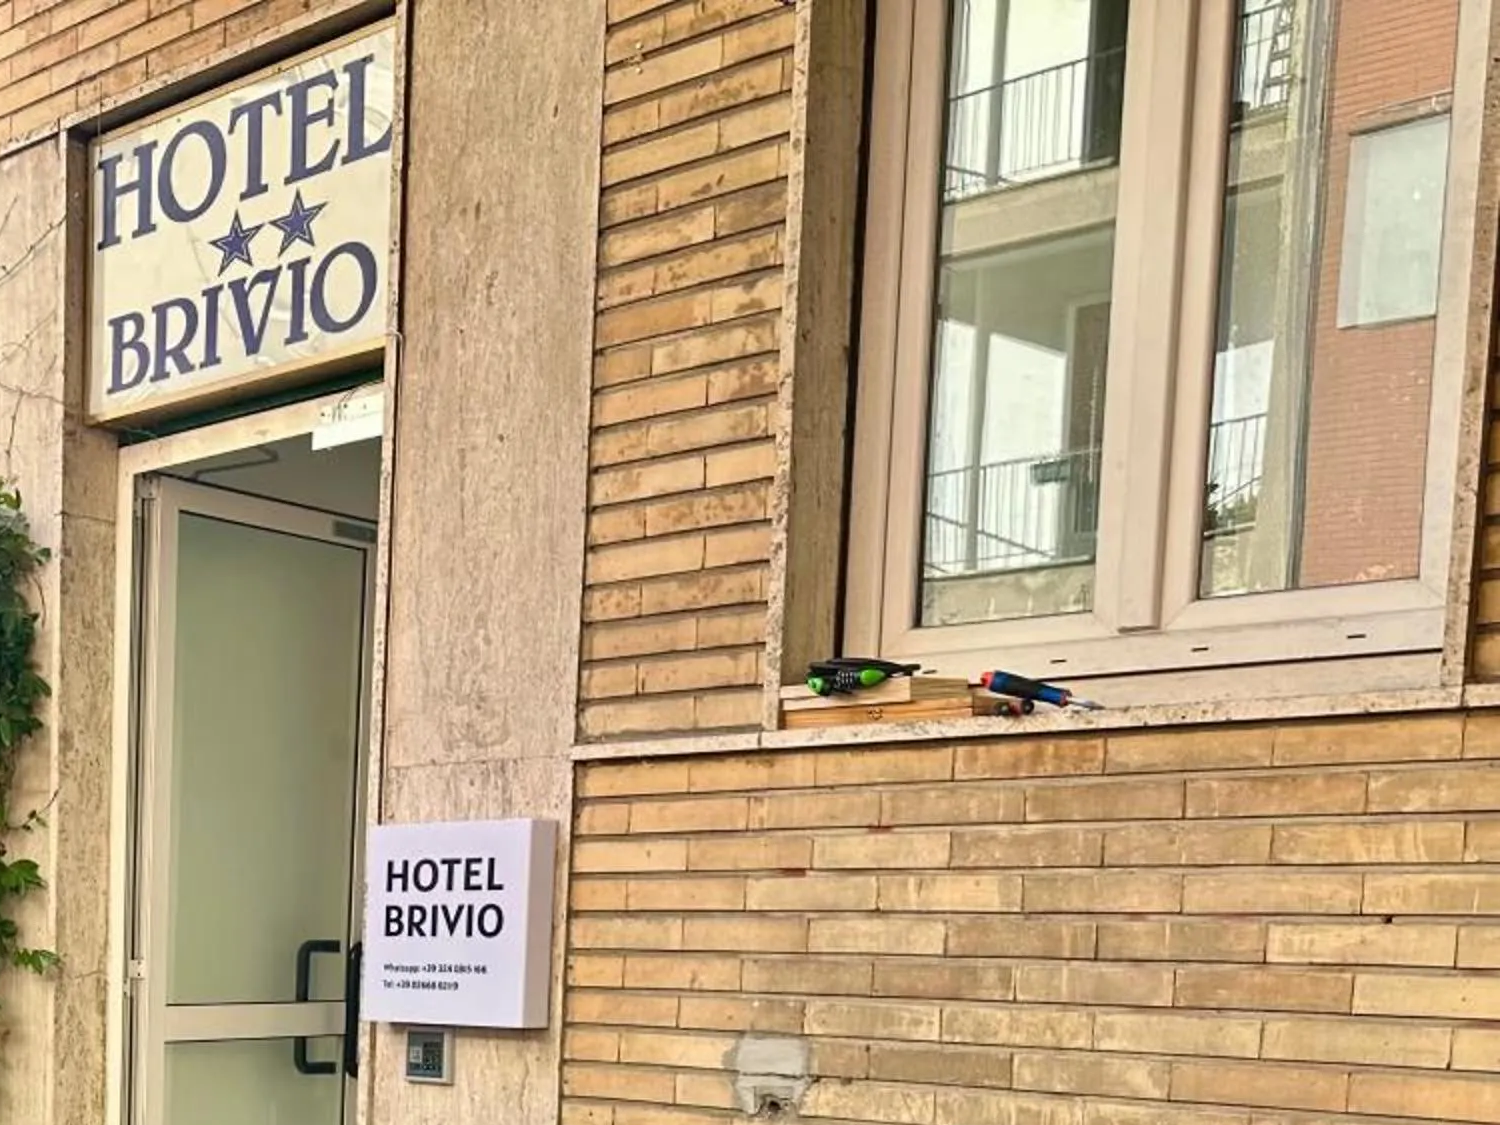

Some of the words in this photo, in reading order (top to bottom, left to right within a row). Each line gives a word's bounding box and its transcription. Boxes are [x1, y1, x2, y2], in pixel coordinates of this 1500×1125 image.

[97, 53, 393, 251] HOTEL
[106, 241, 378, 396] BRIVIO
[384, 903, 505, 938] BRIVIO
[385, 856, 505, 893] HOTEL
